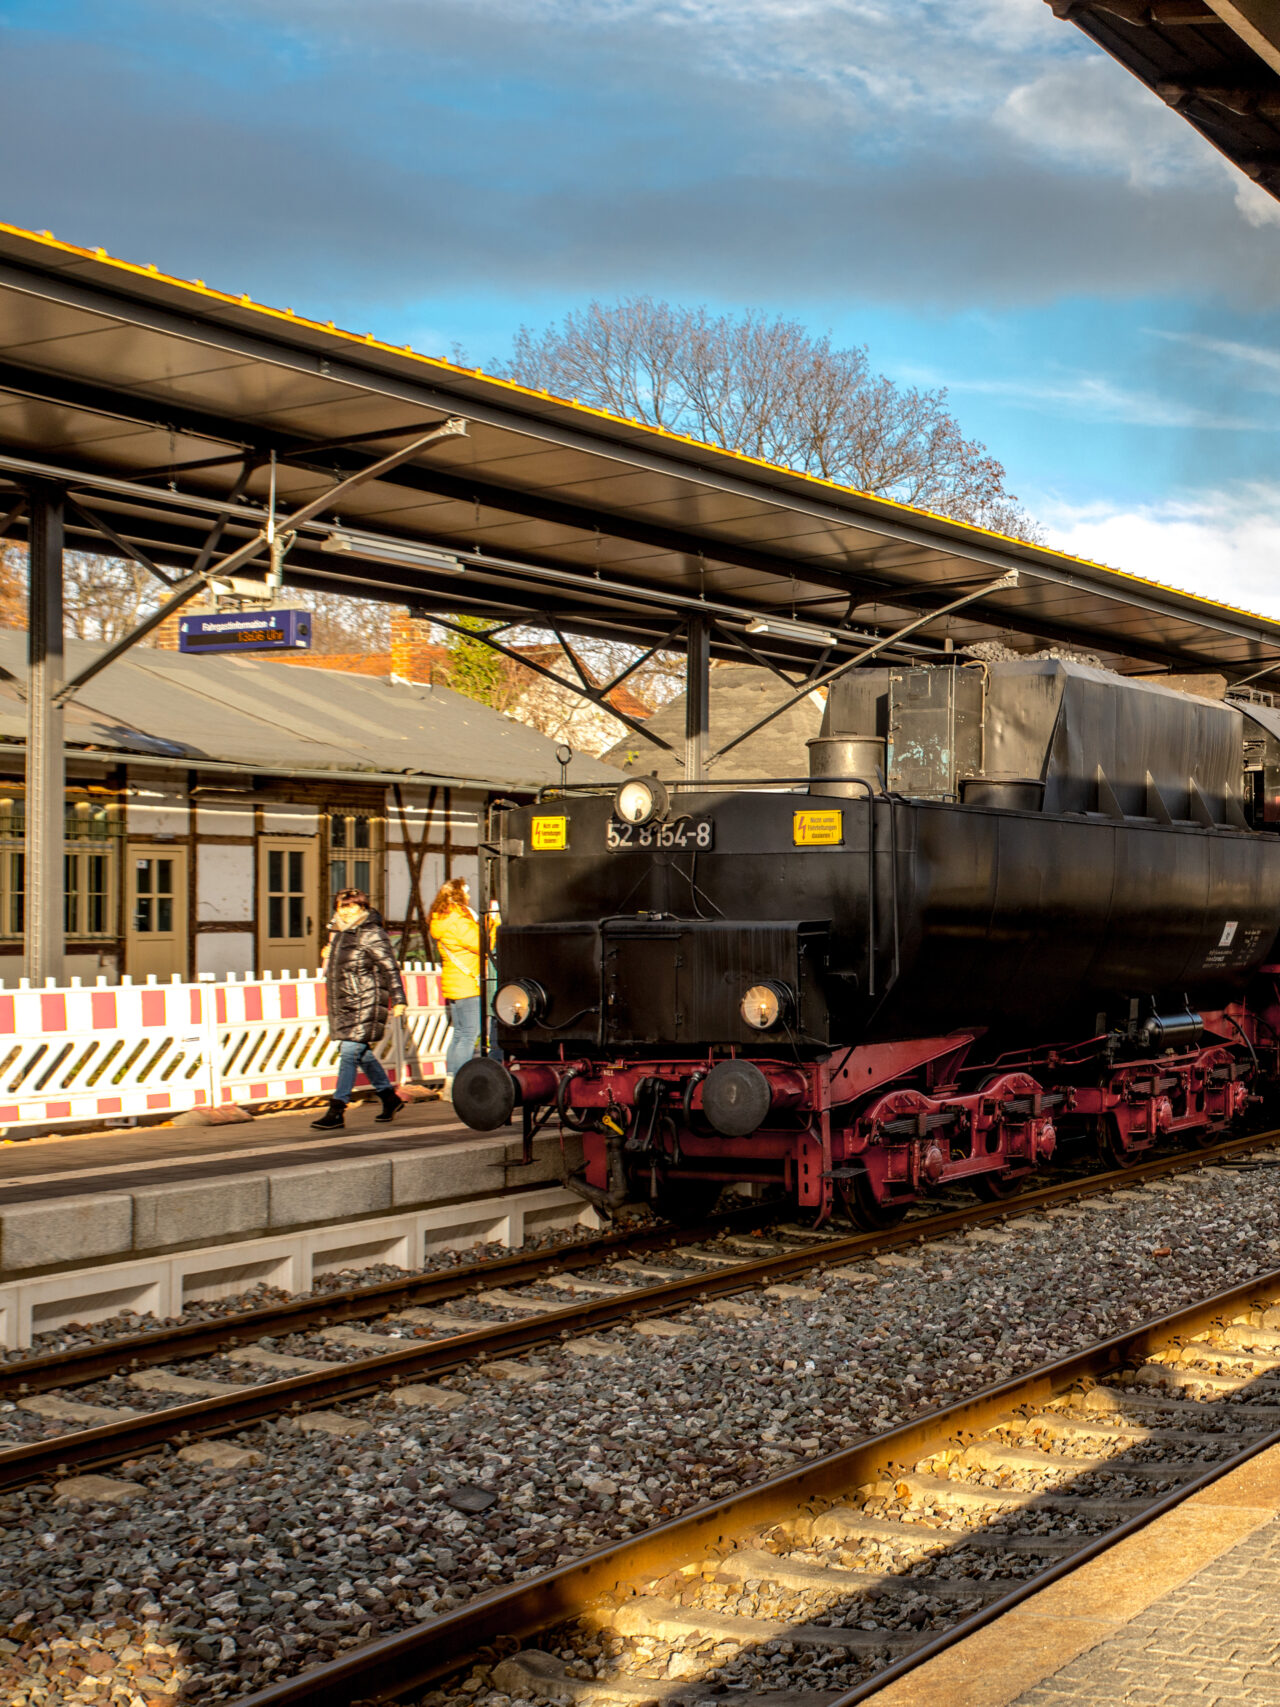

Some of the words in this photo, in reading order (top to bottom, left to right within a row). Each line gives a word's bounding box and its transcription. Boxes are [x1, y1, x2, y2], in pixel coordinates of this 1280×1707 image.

[202, 620, 268, 632] Fahrgastinformation
[238, 631, 265, 642] 13:06
[266, 630, 284, 641] Uhr
[607, 823, 633, 847] 52
[639, 822, 710, 847] 8154-8
